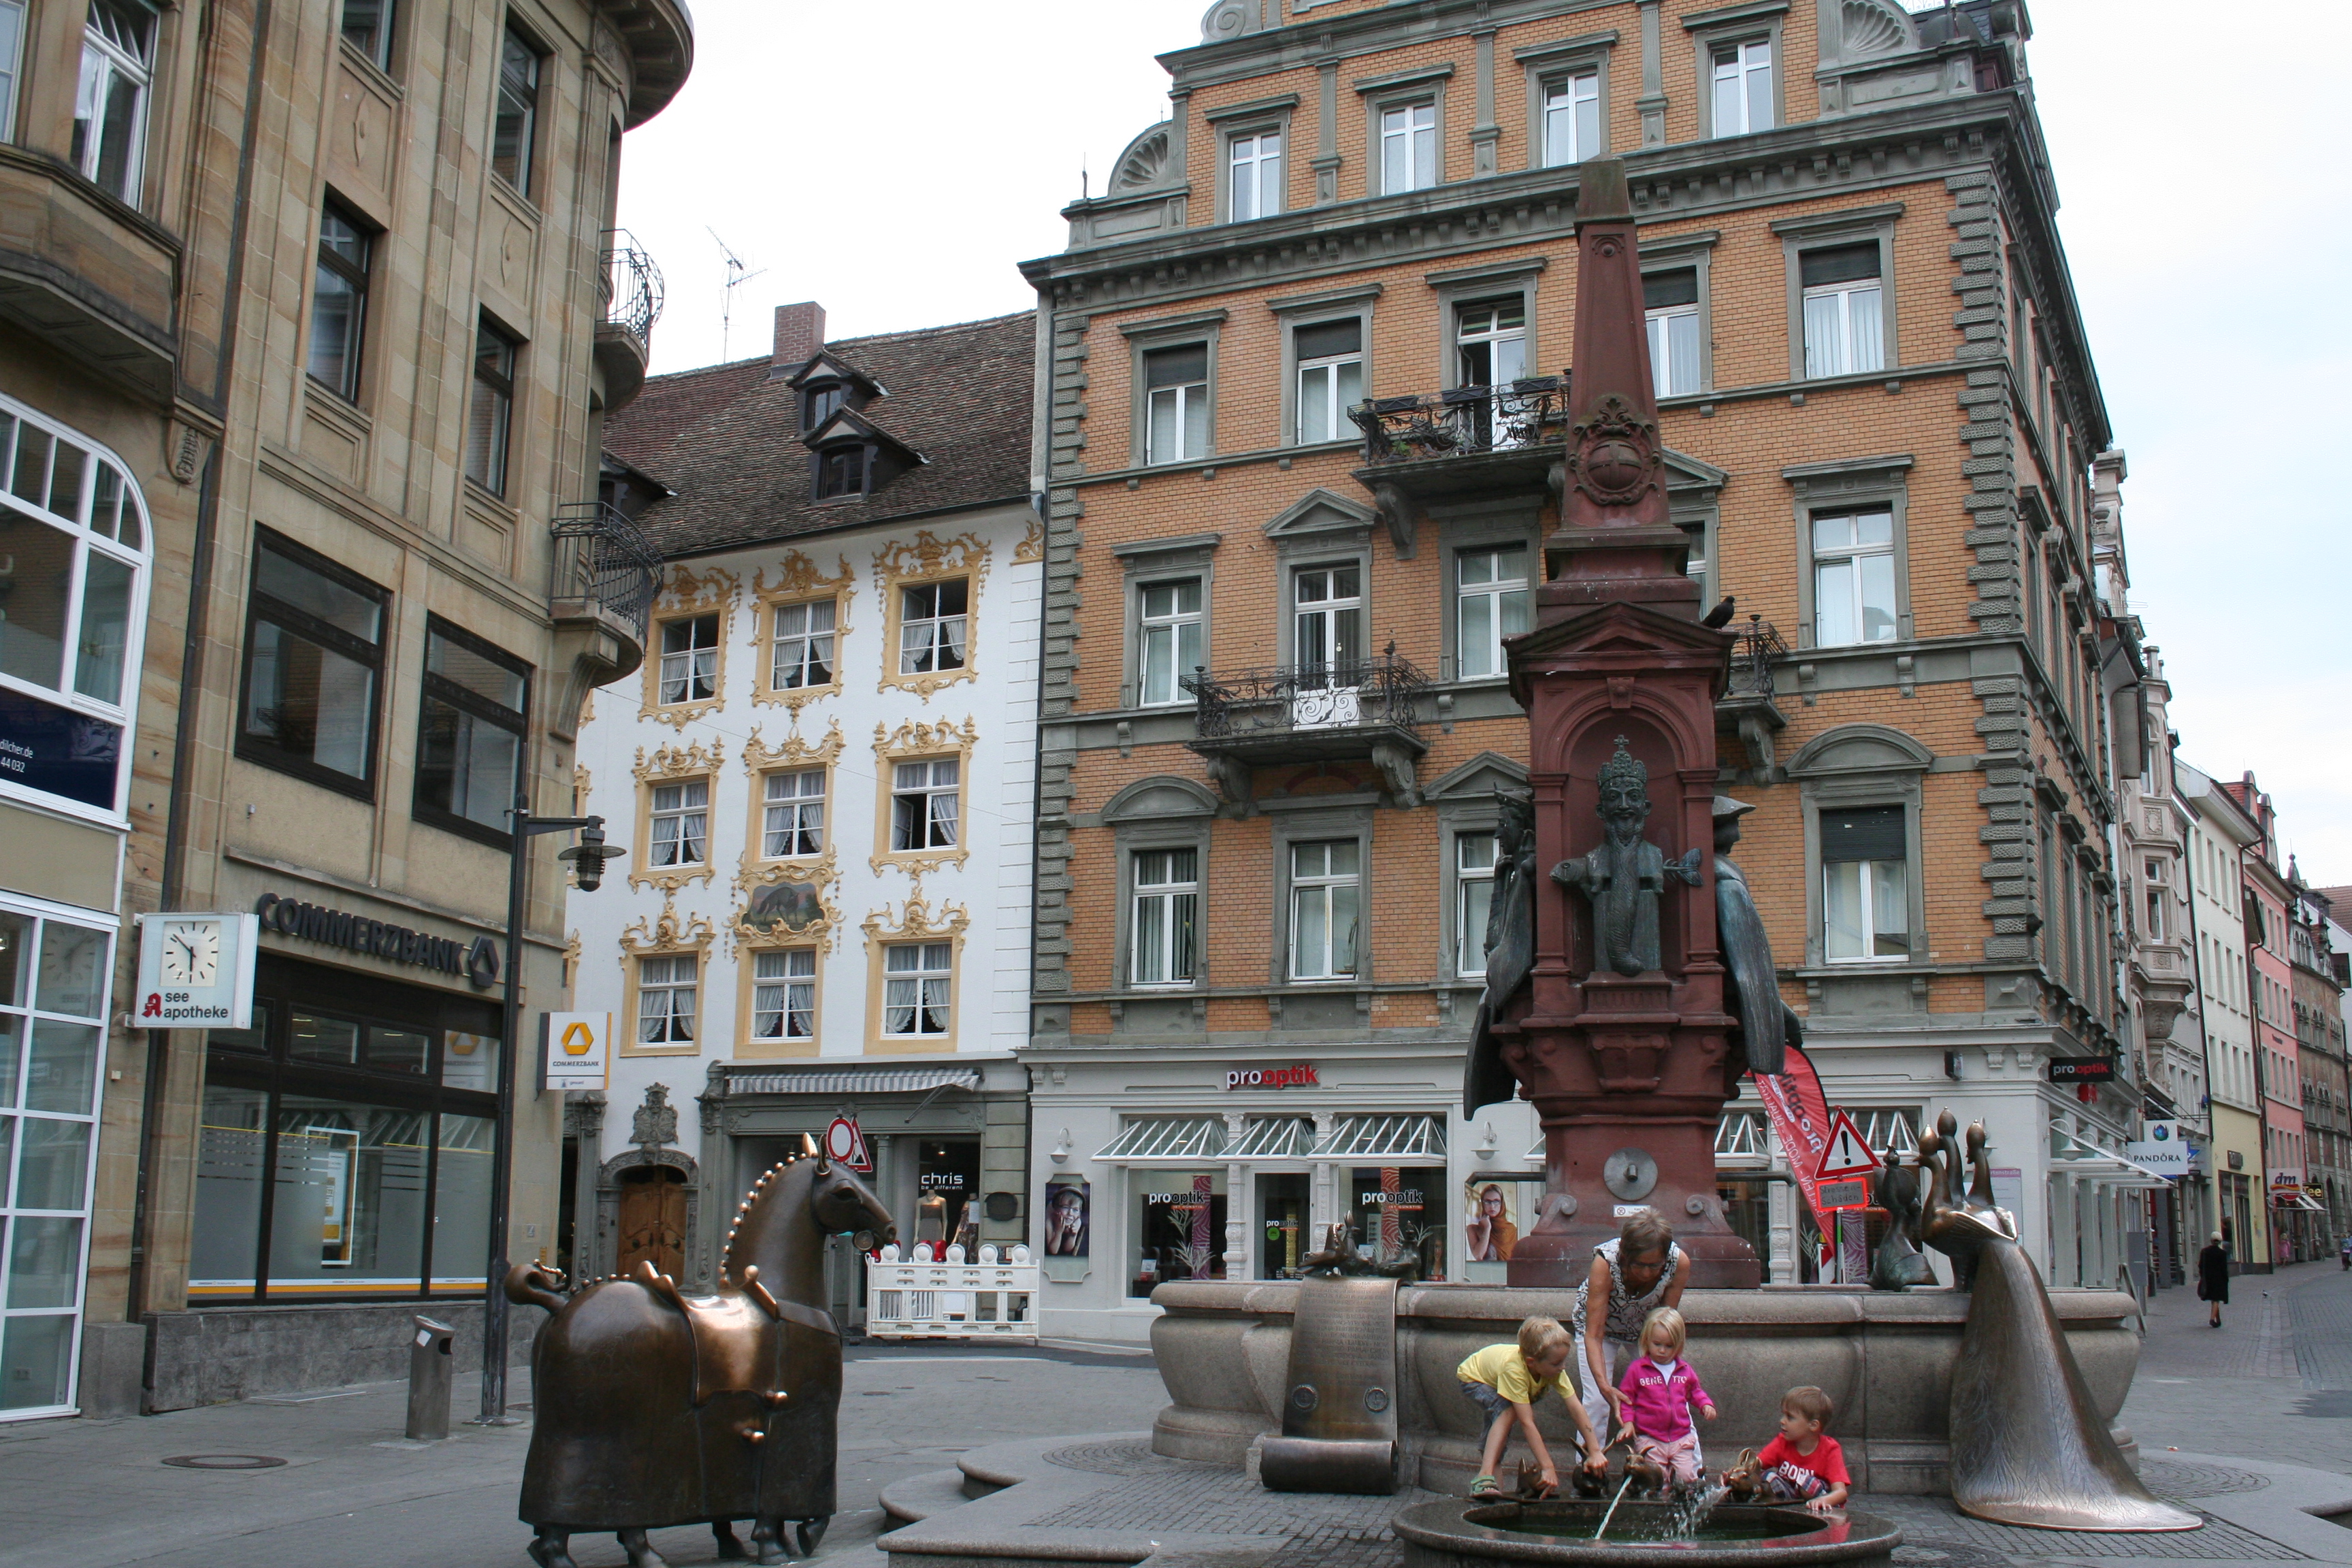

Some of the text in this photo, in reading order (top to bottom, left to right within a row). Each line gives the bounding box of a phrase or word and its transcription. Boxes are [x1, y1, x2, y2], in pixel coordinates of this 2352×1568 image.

[0, 757, 25, 773] 44 032
[257, 893, 464, 975] COMMERZBANK
[165, 992, 189, 1002] see
[164, 1005, 229, 1020] apotheke
[1226, 1064, 1319, 1090] prooptik
[2053, 1063, 2108, 1076] prooptik
[921, 1172, 963, 1184] chris
[2274, 1173, 2296, 1184] dm
[1149, 1190, 1205, 1205] prooptik
[1362, 1189, 1423, 1205] prooptik
[2303, 1186, 2321, 1196] Tee
